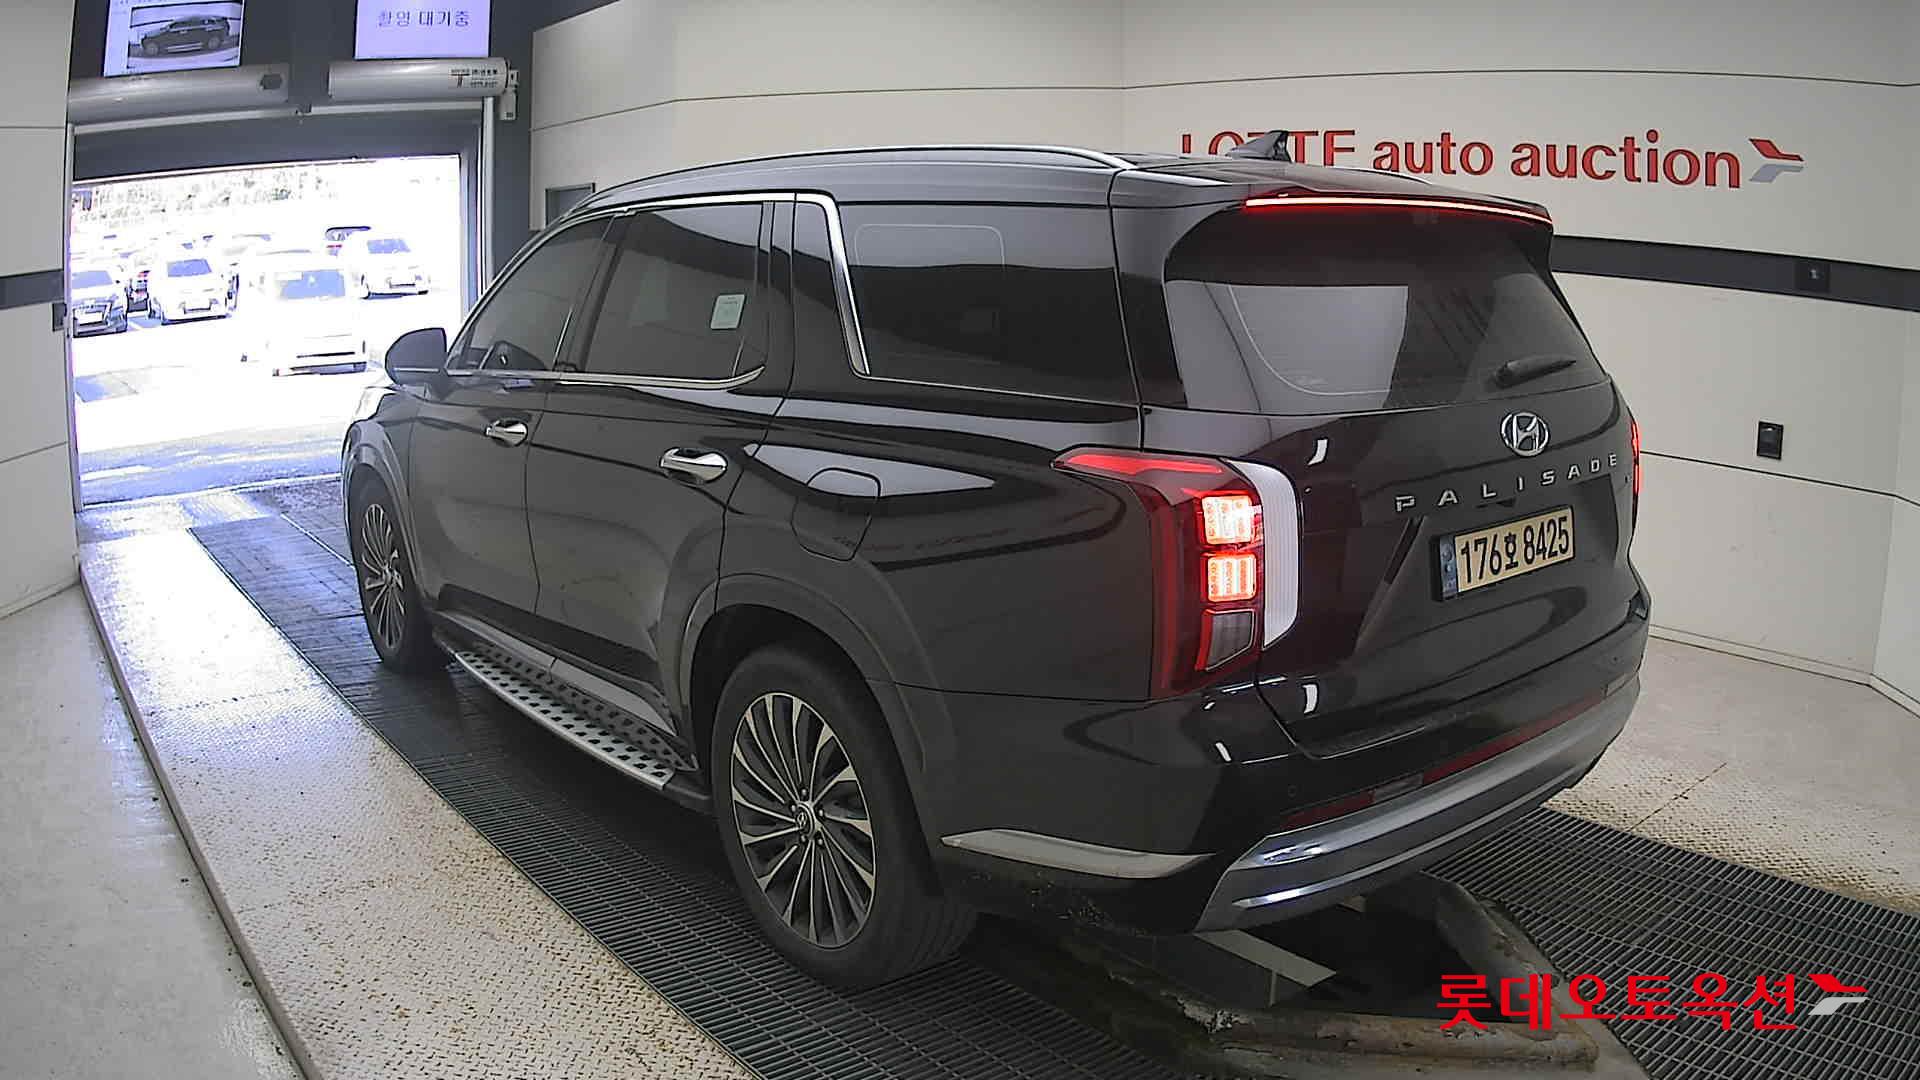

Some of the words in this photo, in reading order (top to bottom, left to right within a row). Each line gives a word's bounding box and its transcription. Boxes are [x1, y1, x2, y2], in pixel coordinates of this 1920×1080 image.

[1181, 130, 1356, 167] OTE
[1372, 131, 1494, 175] auto
[1510, 129, 1741, 189] auction
[1395, 453, 1617, 512] PALISADE
[1523, 515, 1570, 565] 8425
